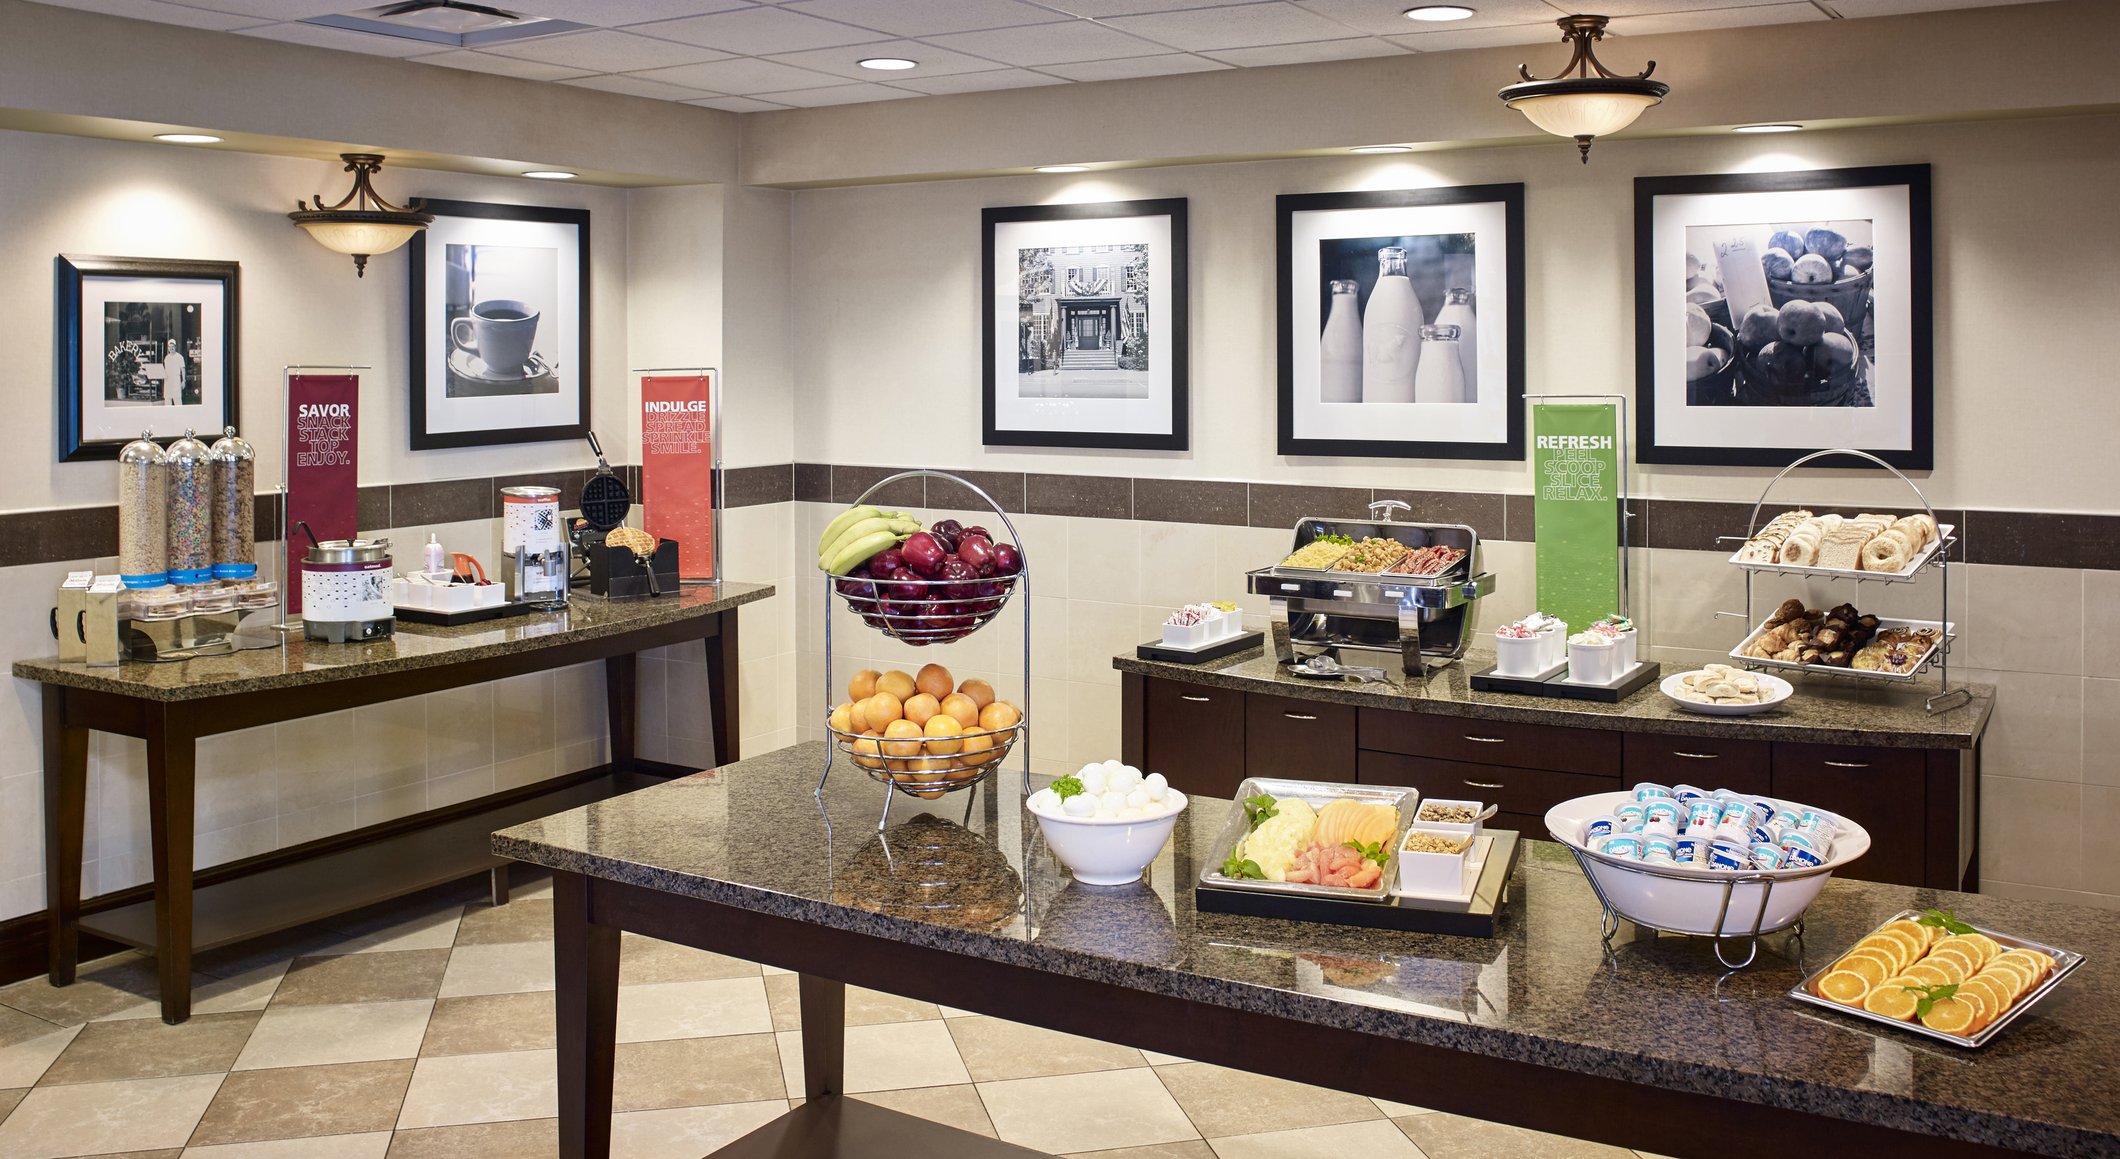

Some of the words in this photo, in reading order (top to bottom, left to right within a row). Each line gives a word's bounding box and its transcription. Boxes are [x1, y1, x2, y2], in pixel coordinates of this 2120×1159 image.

[108, 340, 144, 362] BAKERY
[299, 403, 350, 417] SAVOR
[645, 400, 707, 412] INDULGE
[297, 415, 351, 429] SNACK
[646, 411, 706, 422] DRIZZLE
[646, 421, 706, 432] SPREAD
[299, 428, 349, 442] STACK
[642, 431, 710, 444] SPRINKLE
[1536, 435, 1612, 449] REFRESH
[309, 440, 339, 453] TOP
[651, 442, 702, 454] SMILE.
[297, 451, 351, 466] ENJOY.
[1553, 448, 1597, 461] PEEL
[1544, 460, 1606, 475] SCOOP
[1550, 473, 1601, 487] SLICE
[1543, 486, 1608, 501] RELAX.
